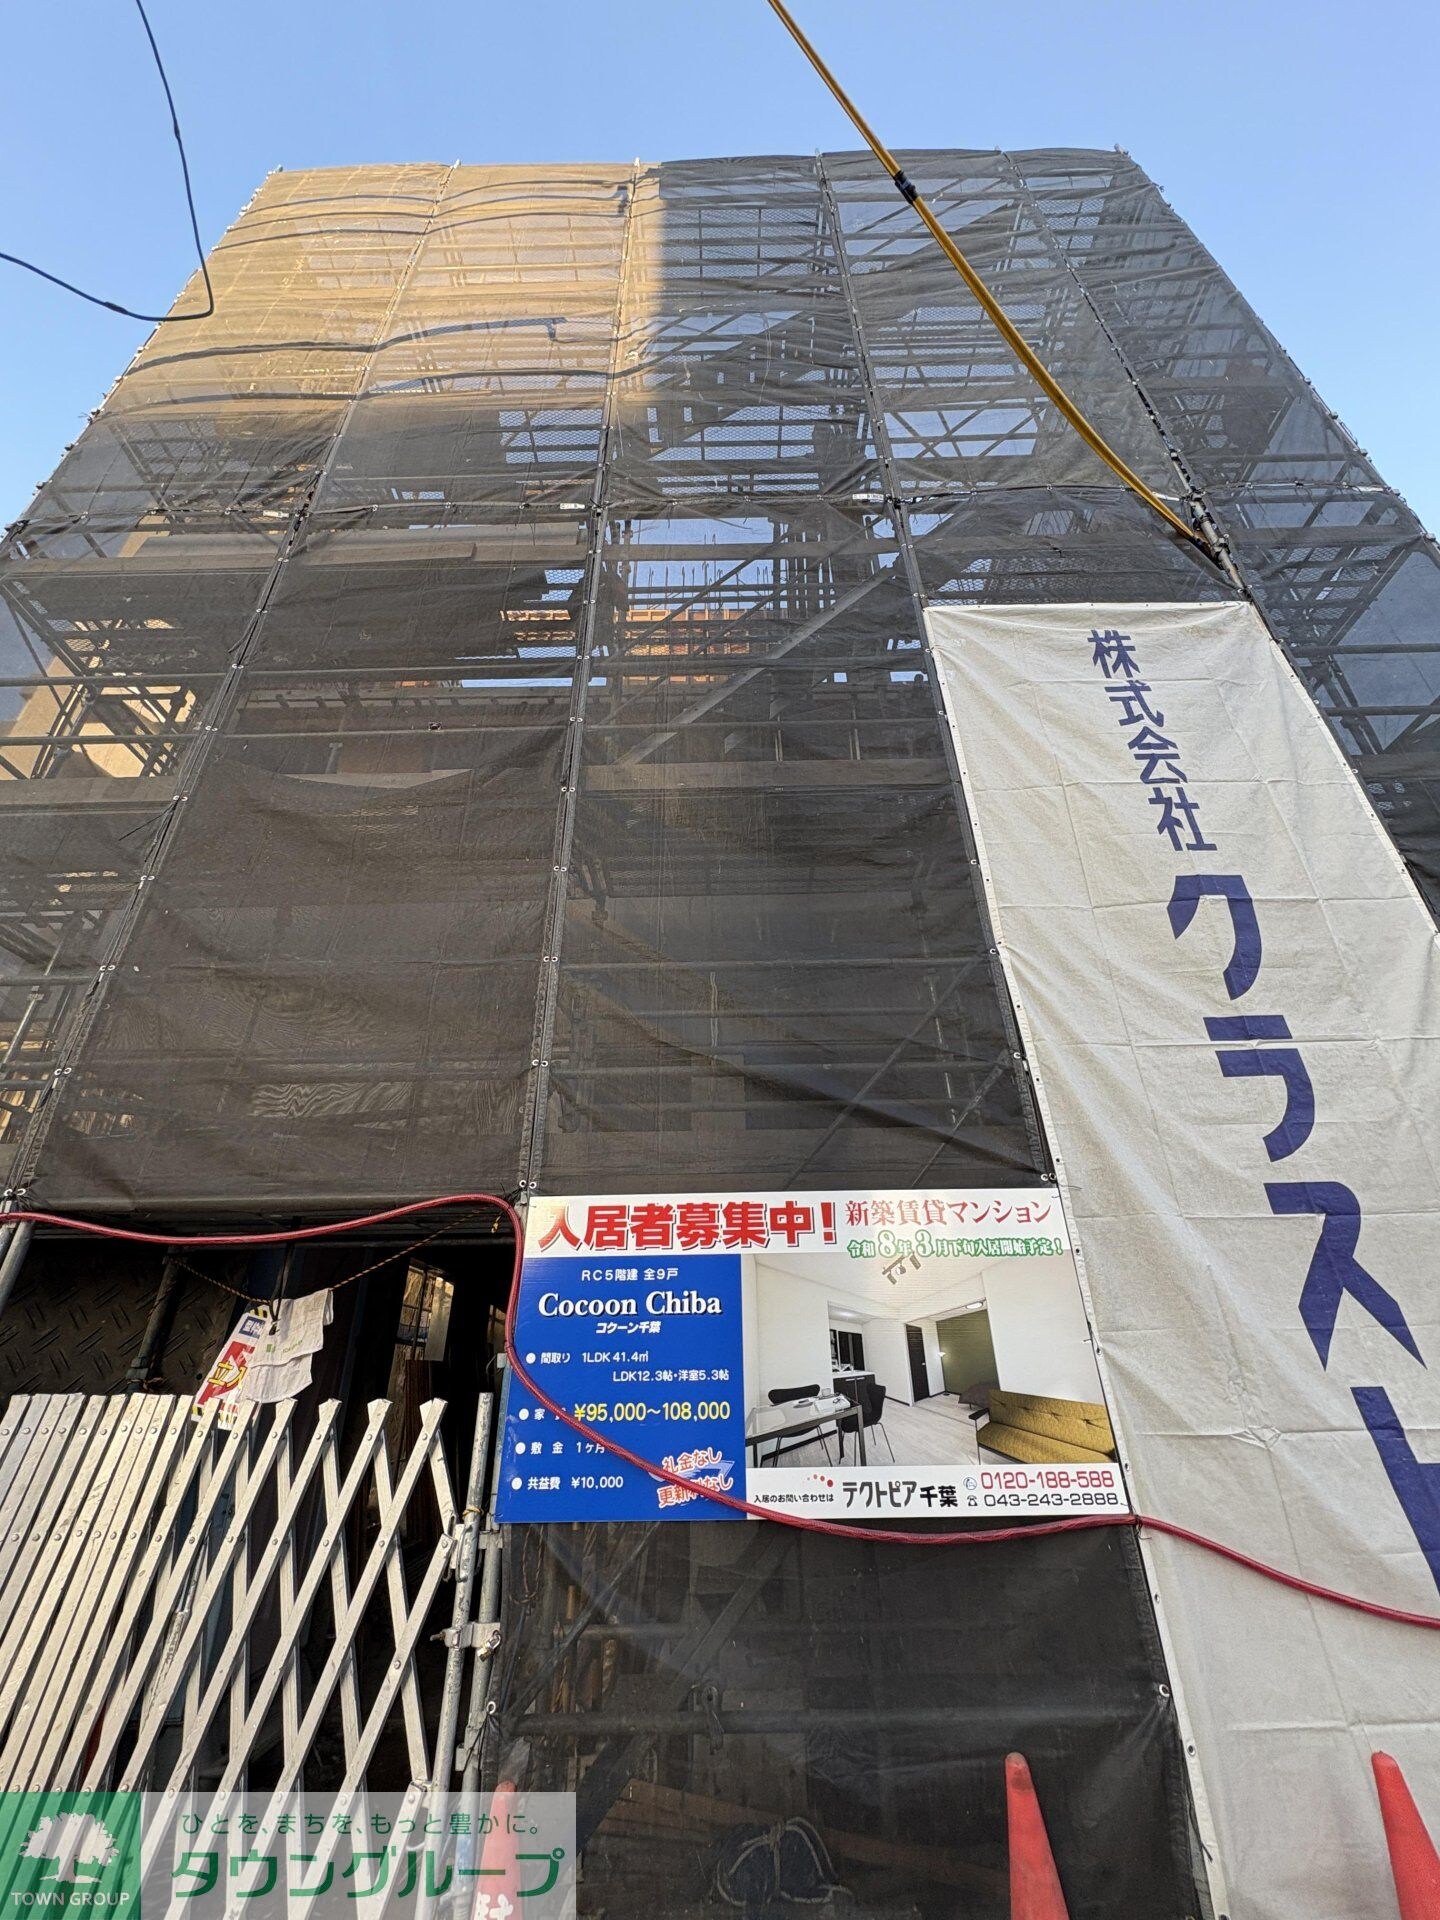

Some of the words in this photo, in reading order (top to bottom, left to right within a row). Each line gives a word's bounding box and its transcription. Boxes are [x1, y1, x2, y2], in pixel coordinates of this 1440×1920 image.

[1087, 629, 1218, 851] 株式会社
[846, 1199, 1051, 1227] 新築賃貸マンション
[538, 1200, 837, 1251] 入居者募集中!
[581, 1269, 638, 1281] RC5階建
[643, 1268, 679, 1280] 全9戸
[538, 1292, 638, 1316] Cocoon
[646, 1290, 722, 1315] Chiba
[596, 1320, 661, 1334] コクーン千葉
[540, 1352, 571, 1364] 間取り
[662, 1447, 722, 1474] 礼金なし
[527, 1477, 561, 1490] 共益費
[571, 1476, 624, 1490] ¥10,000
[981, 1471, 1114, 1489] 0120-188-588
[754, 1493, 834, 1503] 入居のお問い合わせは
[984, 1493, 1119, 1507] 043-243-2888
